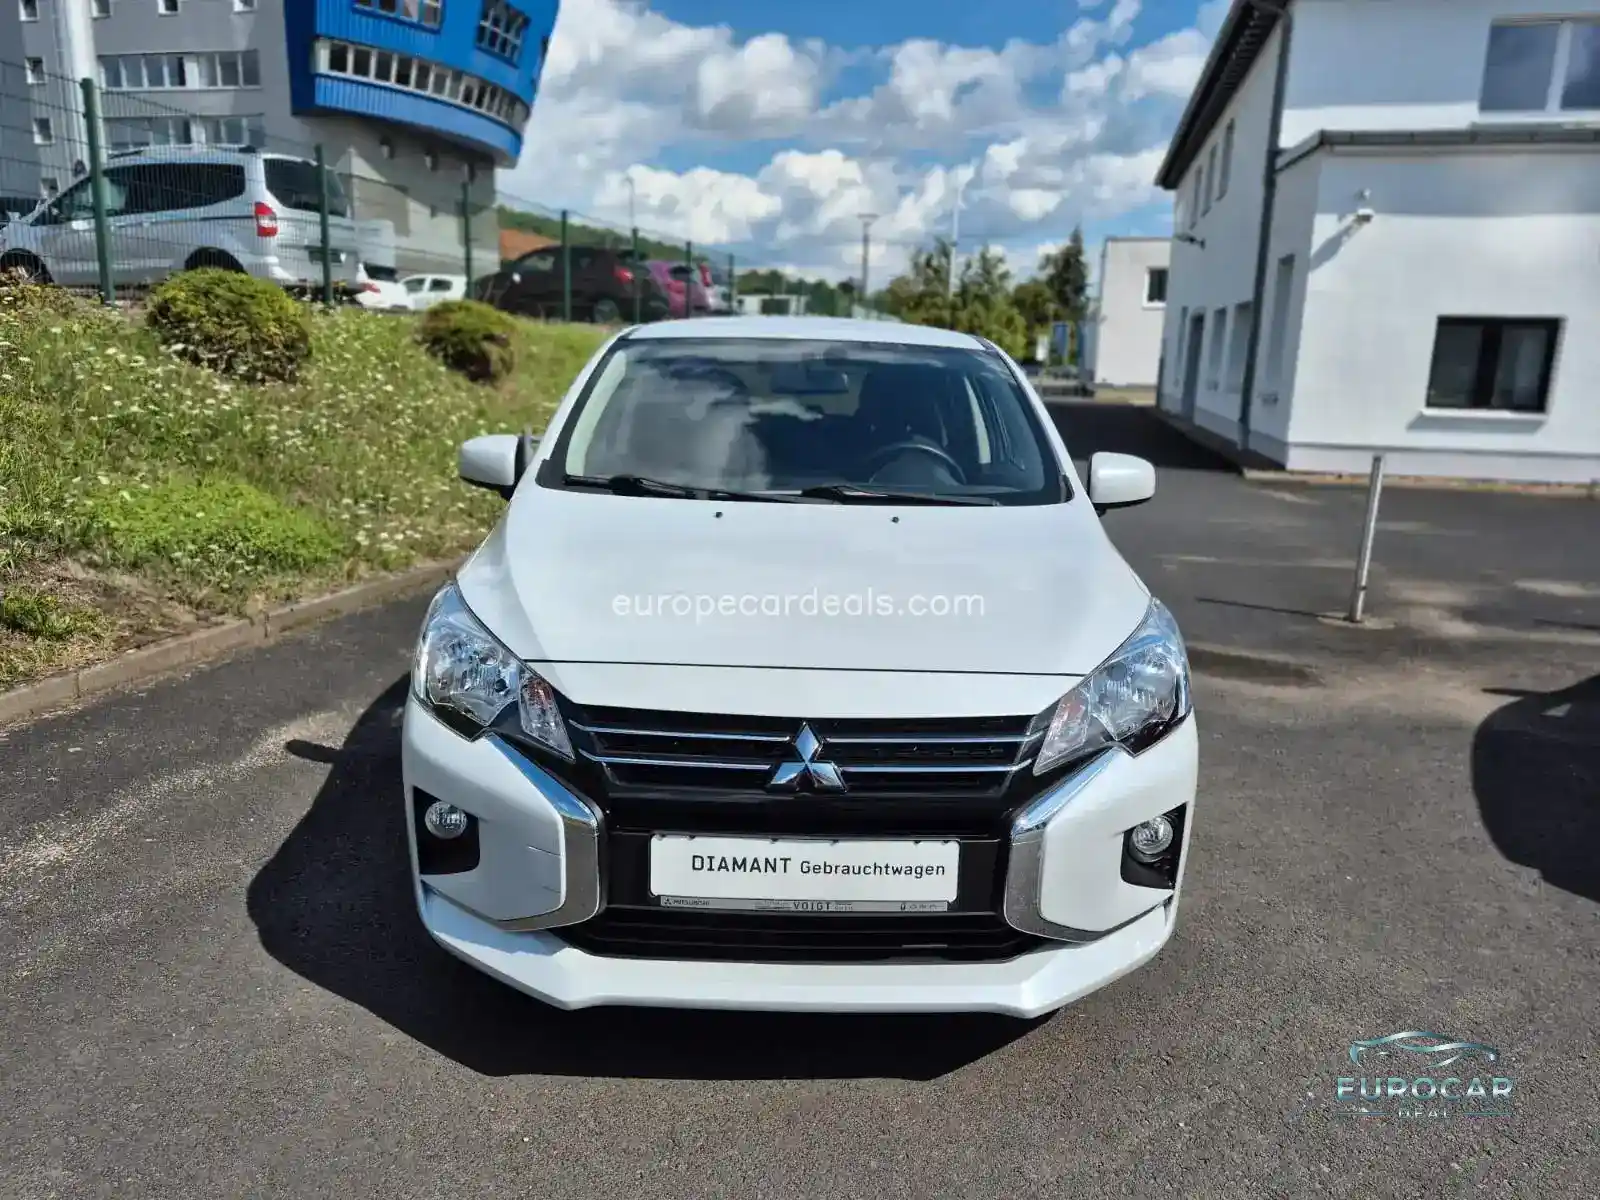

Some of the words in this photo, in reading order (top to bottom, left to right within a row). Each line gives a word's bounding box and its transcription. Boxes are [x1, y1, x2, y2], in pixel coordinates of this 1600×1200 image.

[691, 854, 792, 874] DIAMANT
[799, 860, 946, 879] Gebrauchtwagen
[793, 901, 831, 911] VOIGT
